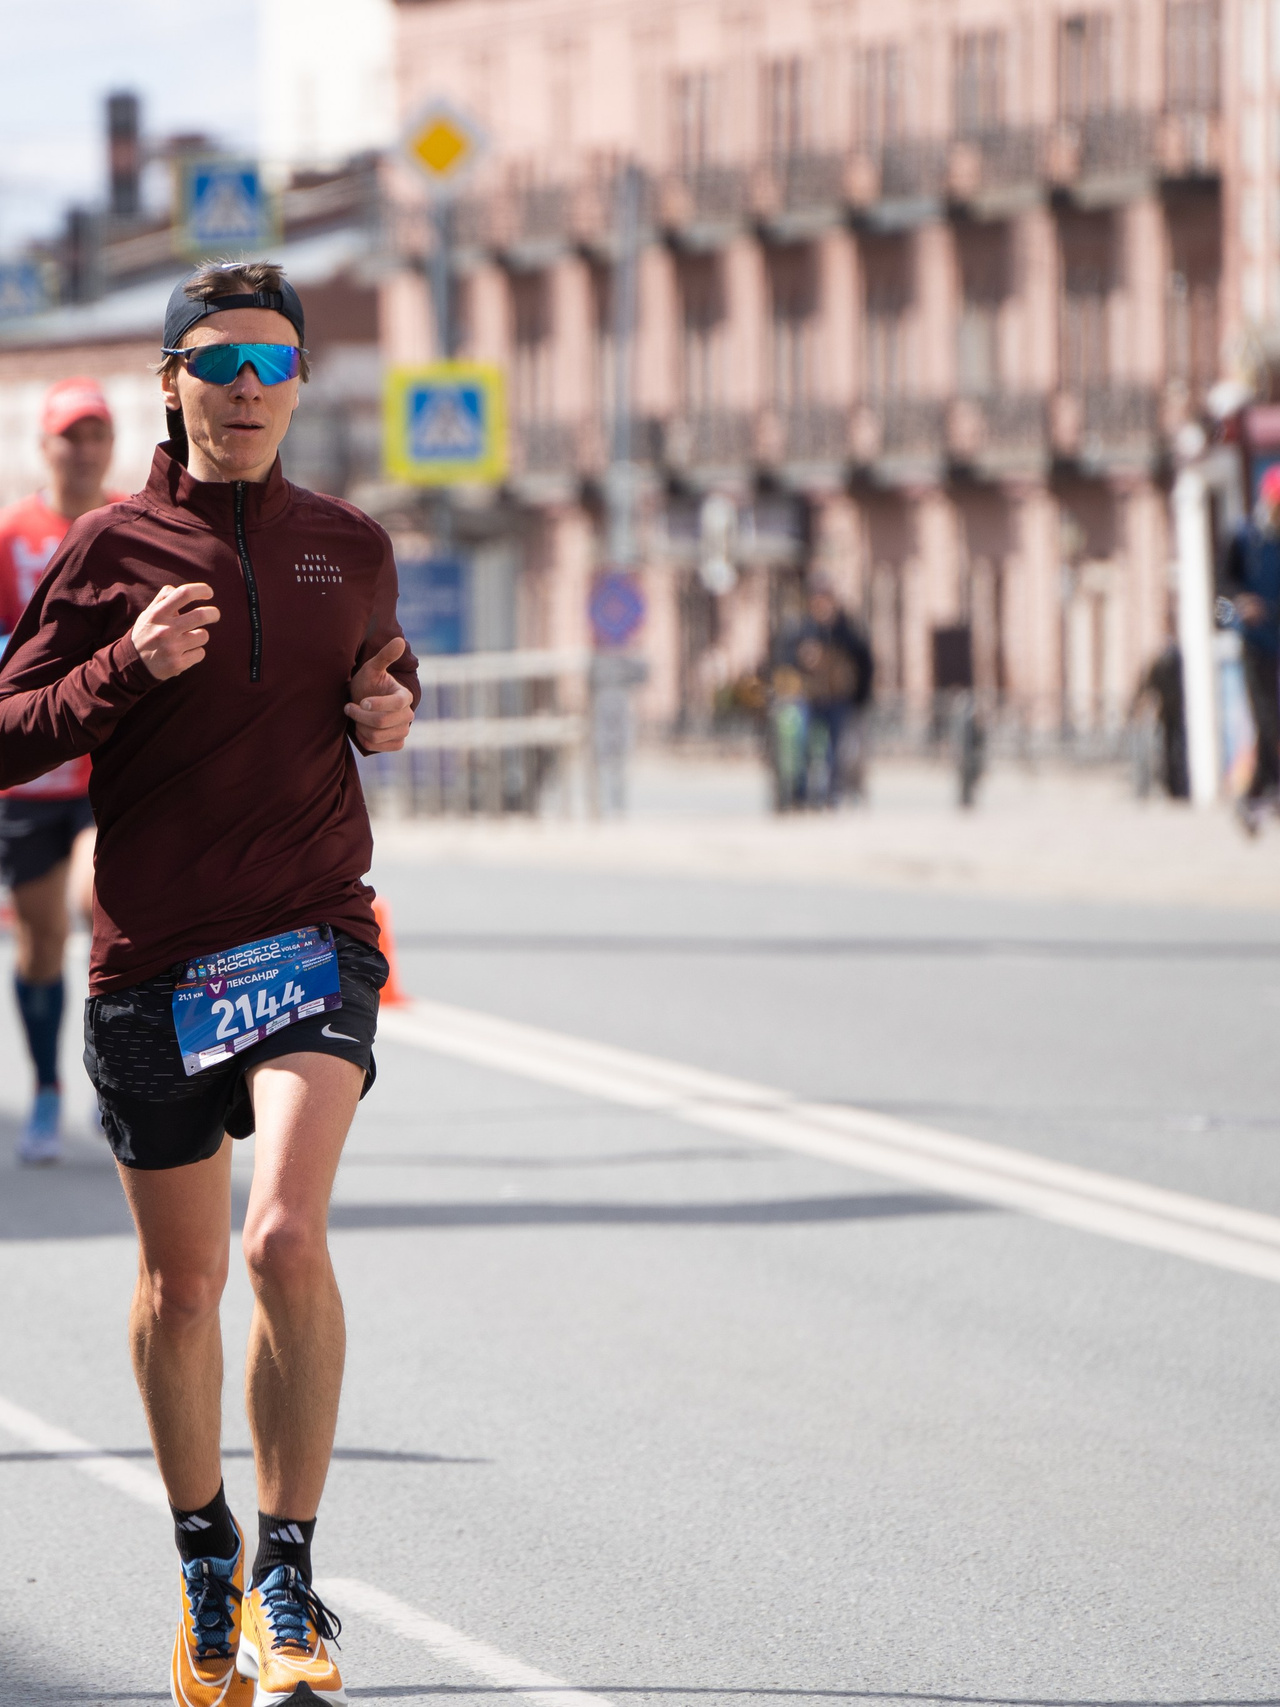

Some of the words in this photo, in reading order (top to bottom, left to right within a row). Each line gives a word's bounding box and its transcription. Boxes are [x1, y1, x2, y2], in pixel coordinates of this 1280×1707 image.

[304, 553, 327, 561] NIKE
[294, 563, 341, 572] RUNNING
[296, 575, 343, 583] DIVISION
[217, 958, 226, 966] Я
[227, 942, 280, 963] ПРОСТО
[217, 950, 282, 974] КОСМОС
[178, 993, 192, 1002] 21,1
[211, 980, 306, 1041] 2144
